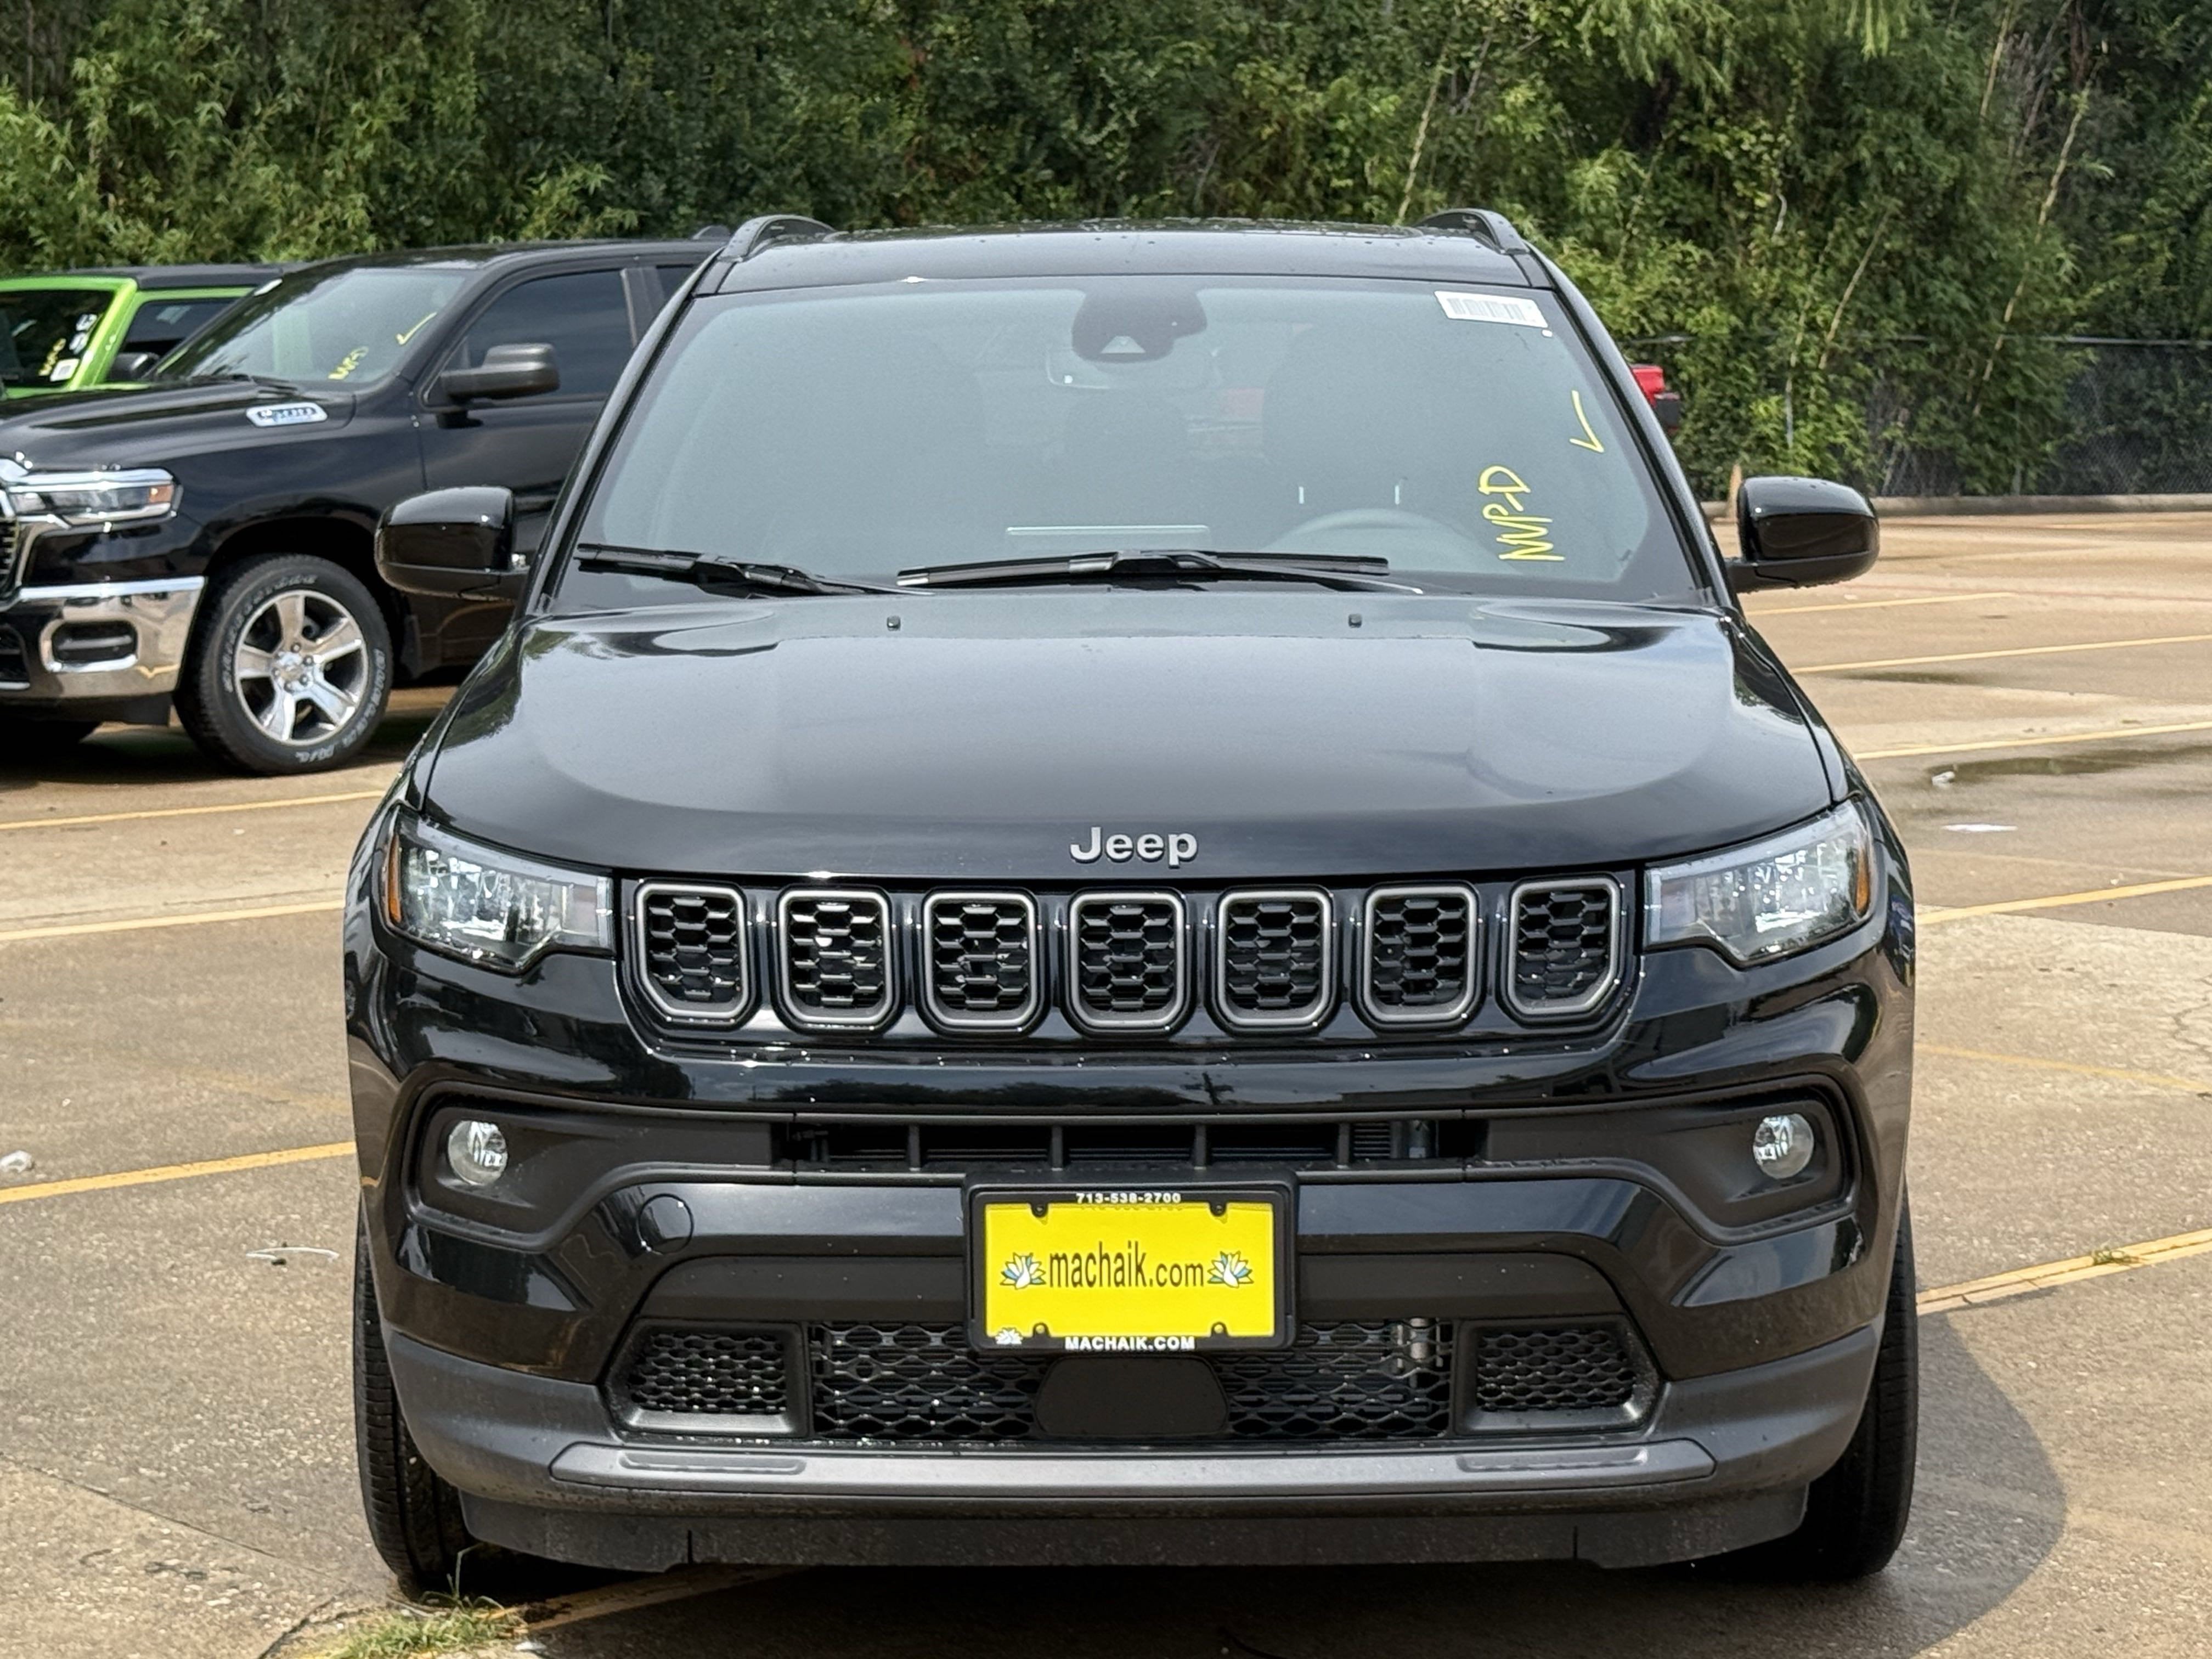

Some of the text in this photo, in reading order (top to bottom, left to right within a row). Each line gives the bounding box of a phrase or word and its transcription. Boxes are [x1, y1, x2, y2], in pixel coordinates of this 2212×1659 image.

[1070, 827, 1198, 868] Jeep
[1075, 1193, 1182, 1204] 713-538-2700
[1049, 1240, 1205, 1288] machaik.com
[1064, 1336, 1195, 1351] MACHAIK.COM
